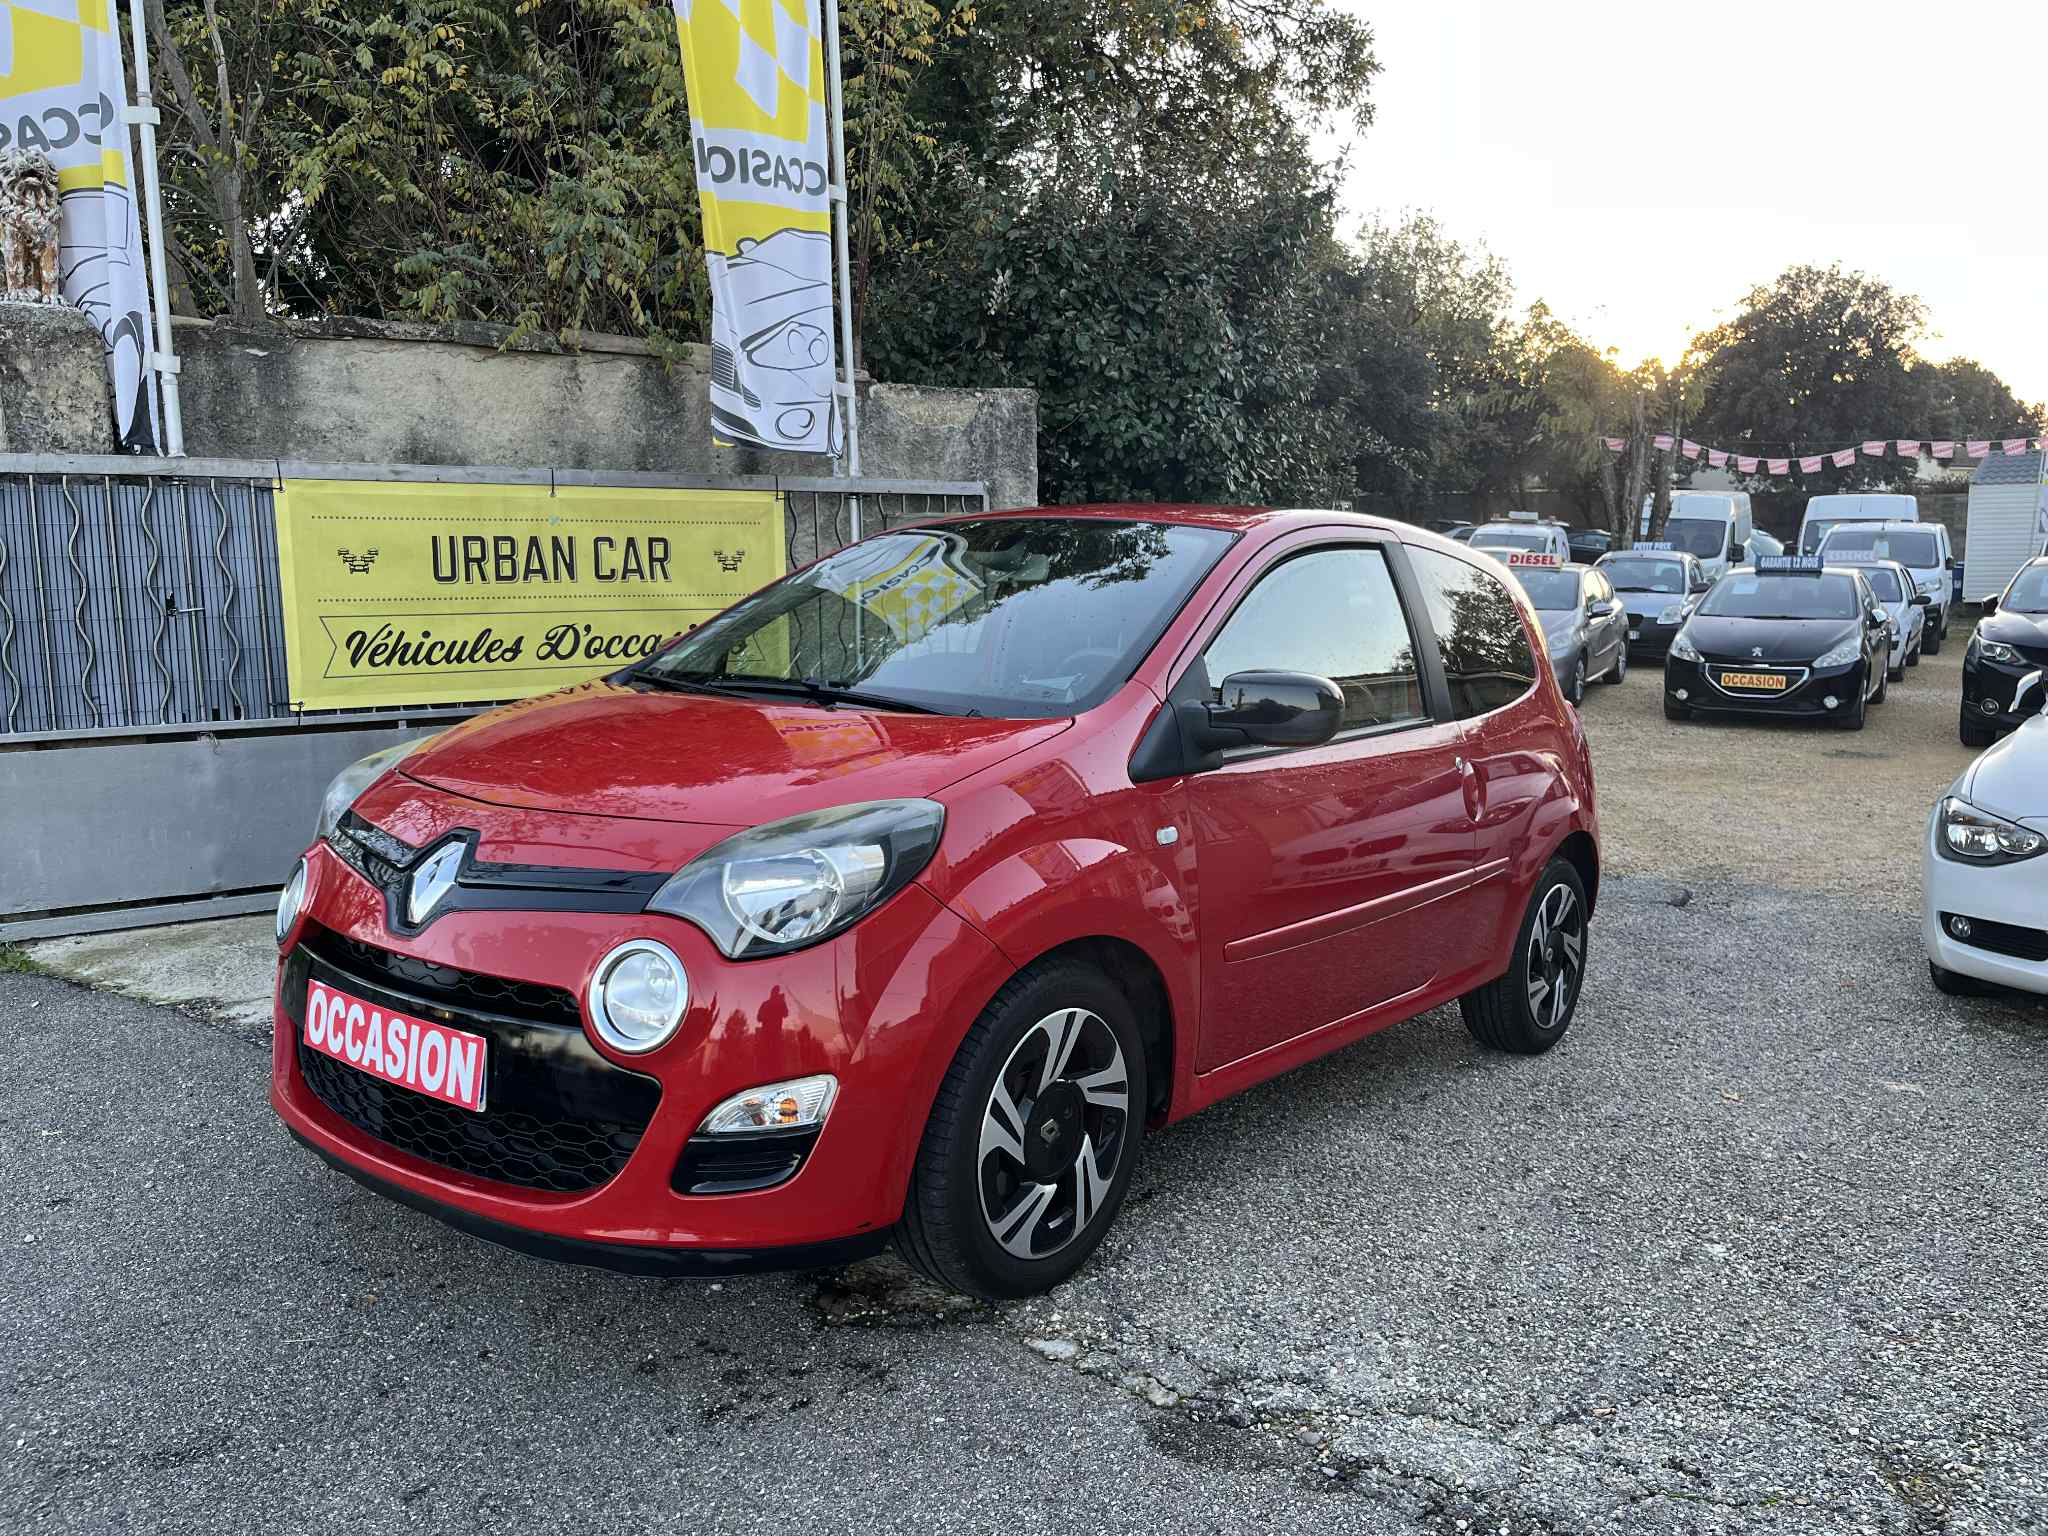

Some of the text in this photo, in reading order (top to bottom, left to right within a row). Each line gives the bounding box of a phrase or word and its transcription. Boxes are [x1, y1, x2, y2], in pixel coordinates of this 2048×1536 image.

[431, 535, 673, 584] URBAN CAR
[1509, 553, 1557, 565] DIESEL
[345, 622, 525, 668] Véhicules
[1722, 674, 1785, 688] OCCASION
[308, 988, 478, 1104] OCCASION
